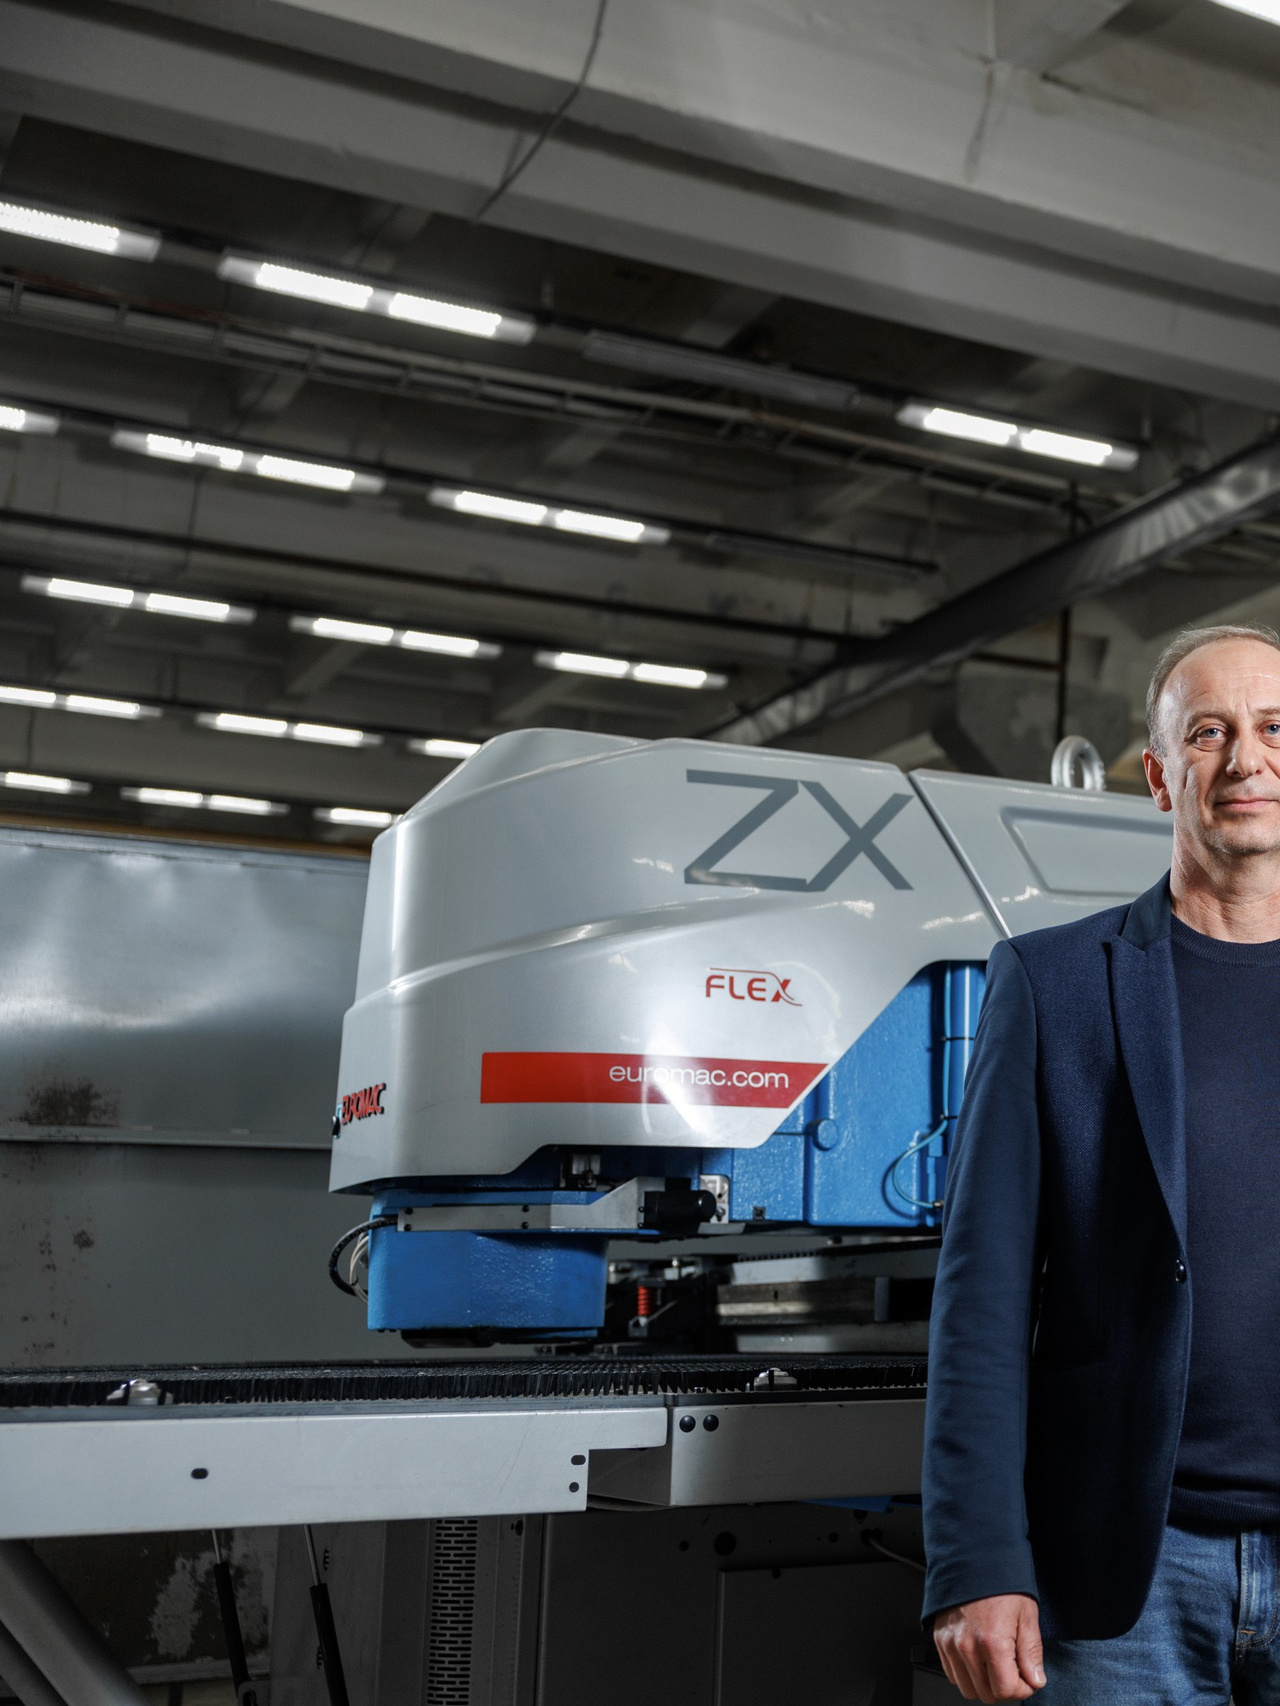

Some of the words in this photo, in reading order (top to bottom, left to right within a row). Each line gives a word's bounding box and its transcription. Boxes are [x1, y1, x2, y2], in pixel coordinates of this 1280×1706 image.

[684, 769, 914, 892] ZX
[705, 968, 802, 1007] FLEX
[608, 1065, 789, 1089] euromac.com
[341, 1083, 386, 1126] EUROMAC
